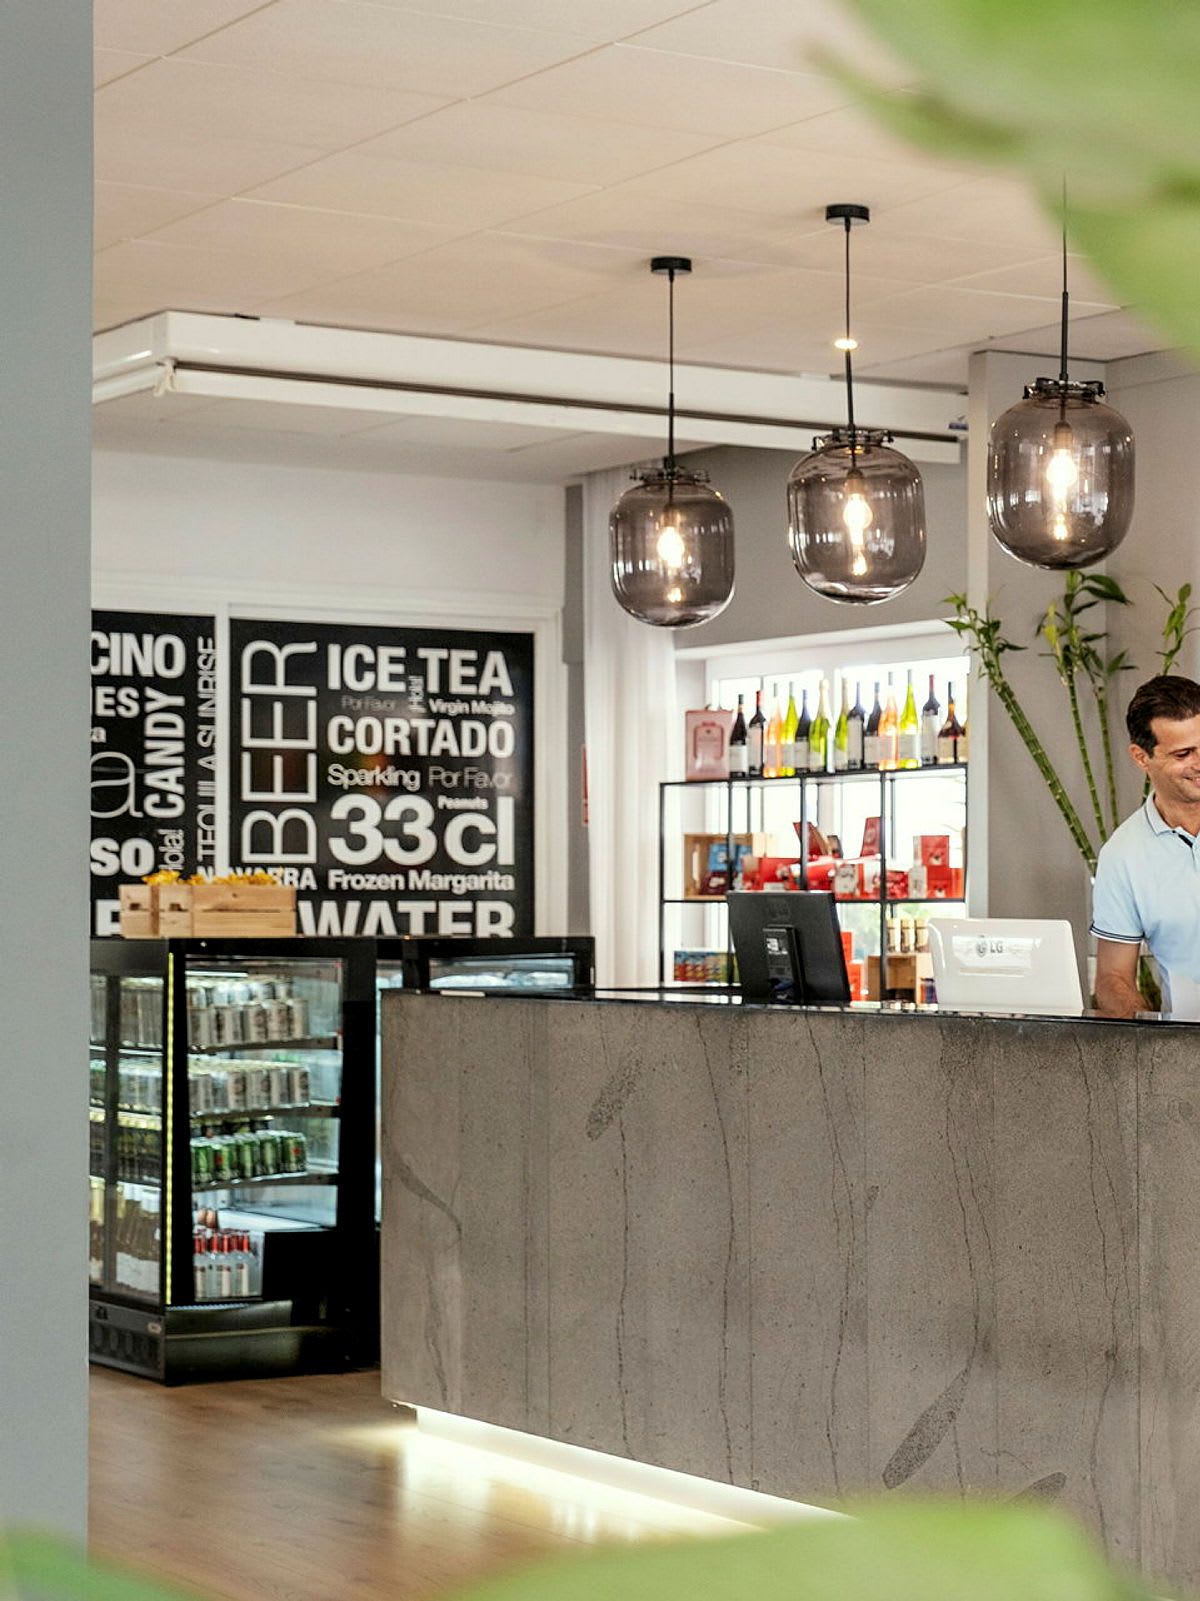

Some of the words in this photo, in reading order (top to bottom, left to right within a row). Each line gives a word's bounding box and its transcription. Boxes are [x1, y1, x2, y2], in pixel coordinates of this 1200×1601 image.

[327, 643, 407, 692] ICE
[416, 648, 515, 697] TEA
[428, 697, 470, 716] Virgin
[143, 685, 186, 819] CANDY
[241, 640, 318, 864] BEER
[327, 715, 515, 759] CORTADO
[428, 765, 462, 788] Por
[327, 868, 405, 891] Frozen
[408, 869, 515, 895] Margarita
[298, 900, 516, 938] WATER
